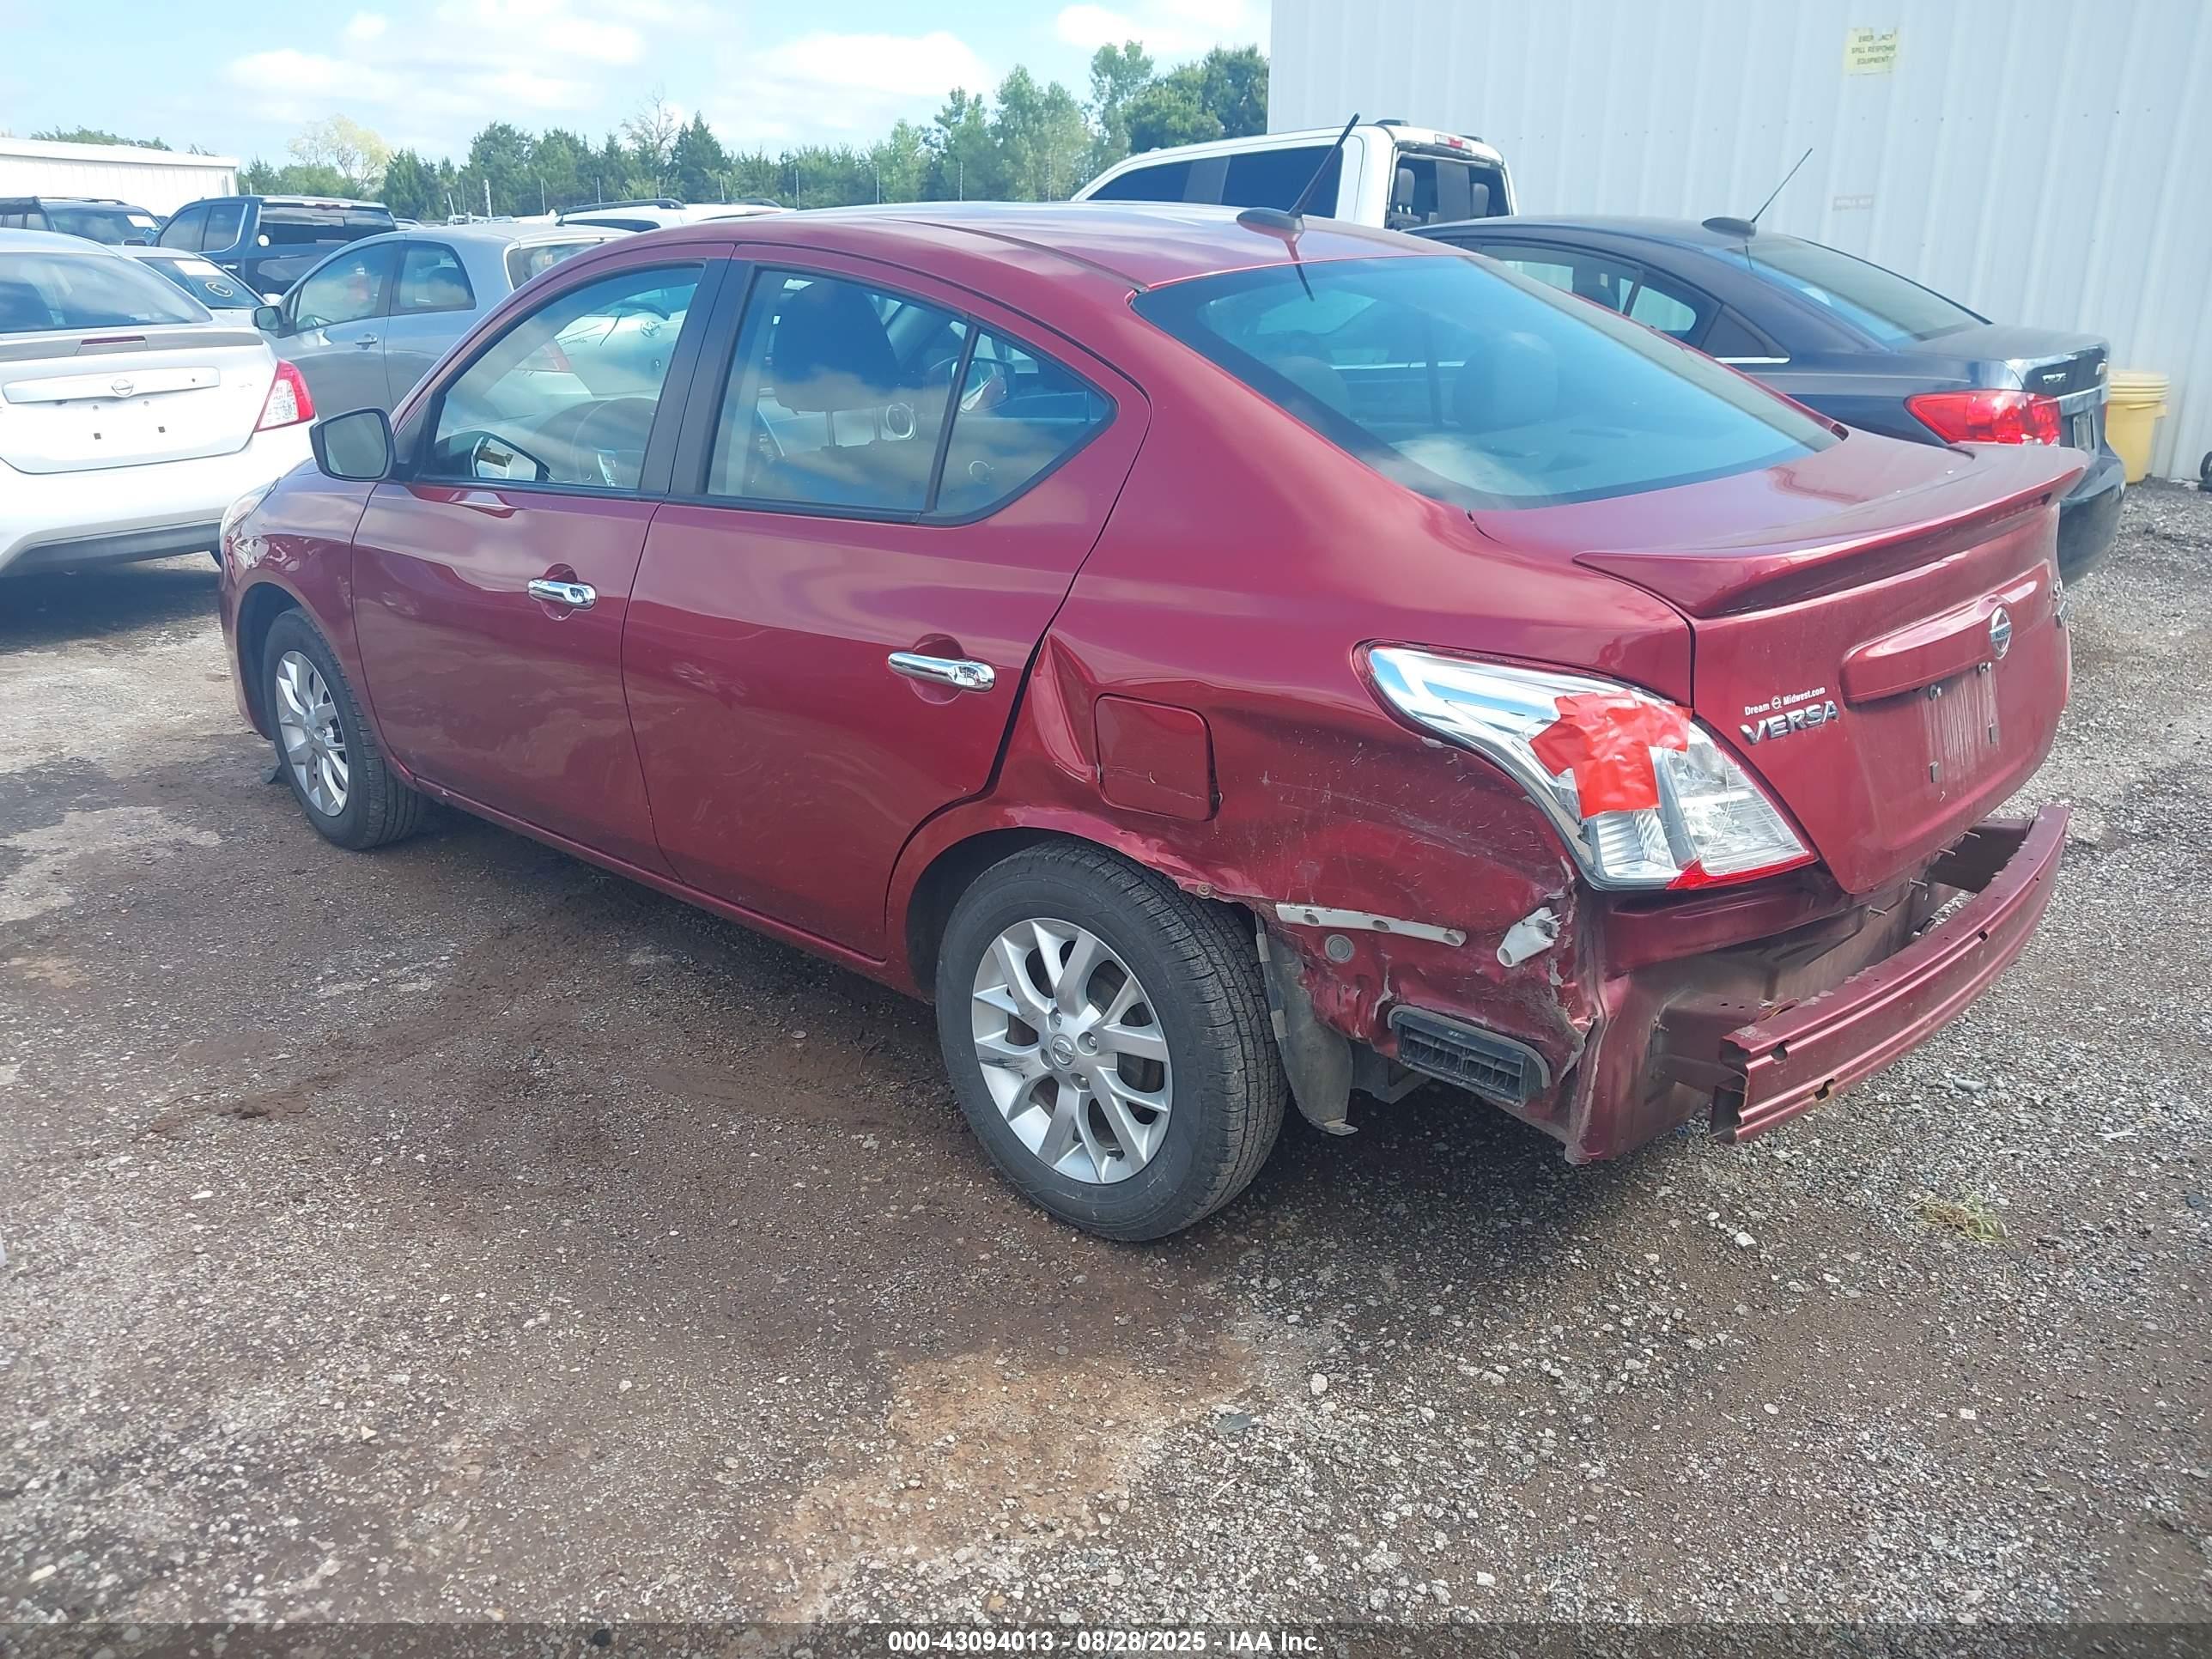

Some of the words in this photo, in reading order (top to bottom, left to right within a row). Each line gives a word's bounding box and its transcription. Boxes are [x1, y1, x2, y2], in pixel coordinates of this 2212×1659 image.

[1744, 702, 1771, 716] Dream
[1783, 686, 1826, 706] Midwest.com
[1740, 700, 1838, 745] VERSA
